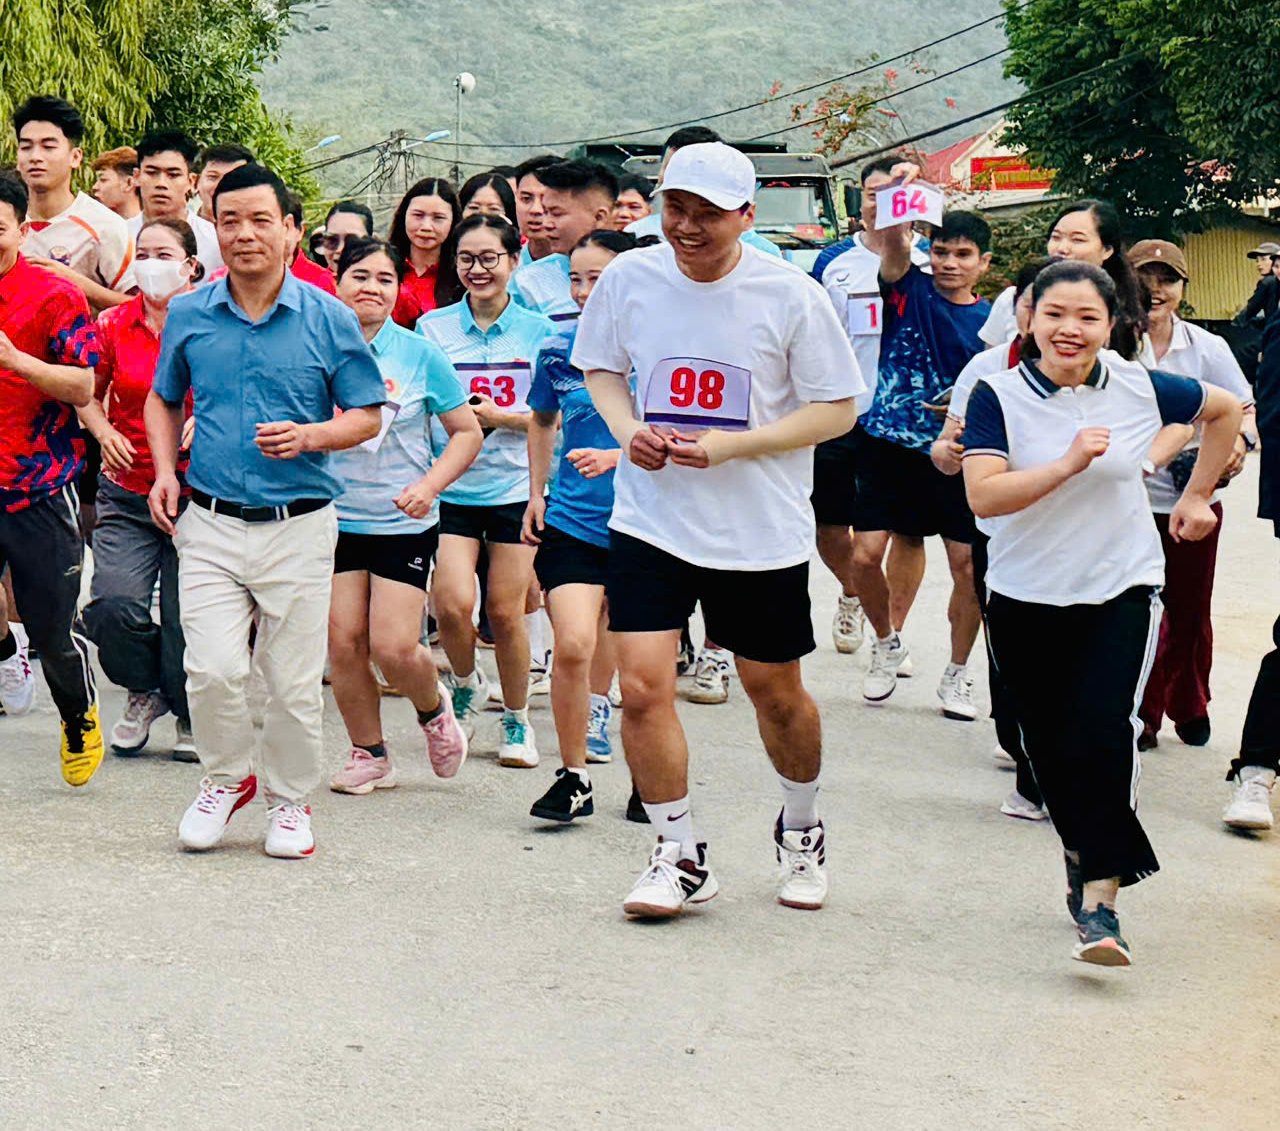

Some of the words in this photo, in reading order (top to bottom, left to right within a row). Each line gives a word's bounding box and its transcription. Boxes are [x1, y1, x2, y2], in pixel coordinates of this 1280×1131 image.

[892, 190, 929, 218] 64
[470, 376, 516, 407] 63
[670, 367, 725, 410] 98
